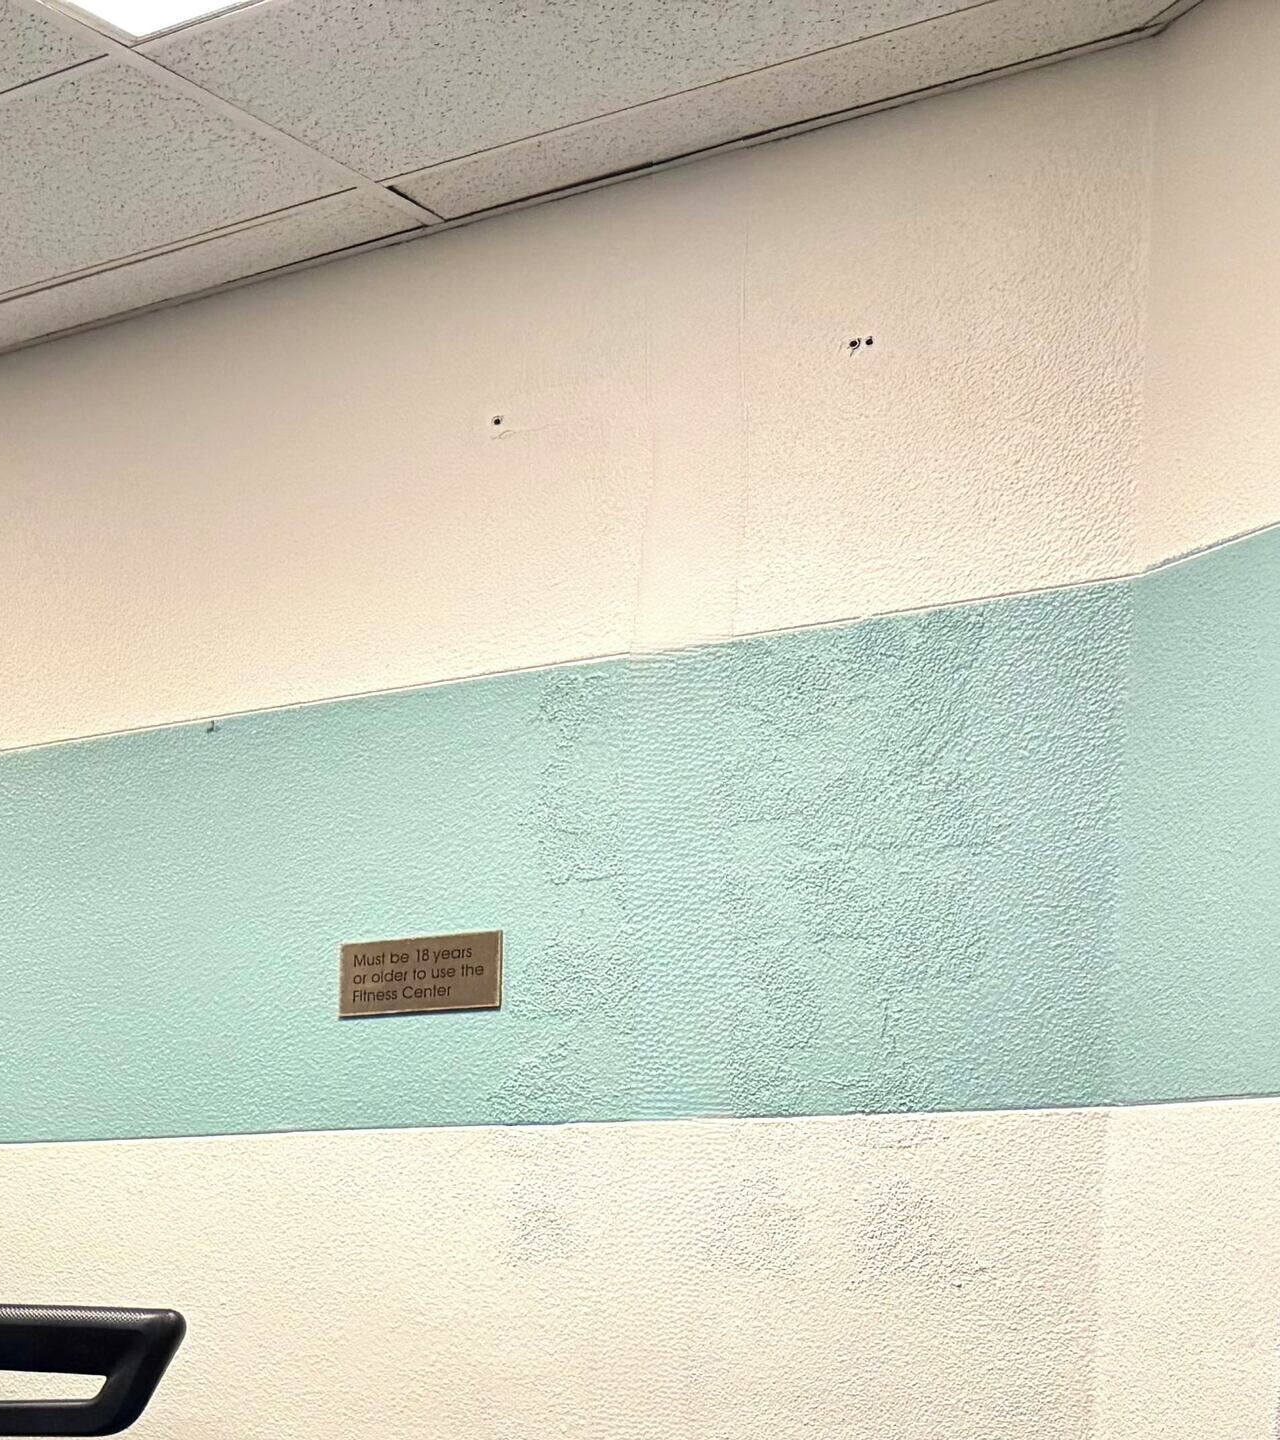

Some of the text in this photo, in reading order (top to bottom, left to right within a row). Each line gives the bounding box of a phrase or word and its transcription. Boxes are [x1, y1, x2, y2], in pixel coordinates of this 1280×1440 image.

[353, 947, 473, 967] Must be 18 years
[352, 963, 484, 985] or older to use the
[352, 984, 452, 1003] Fitness Center
